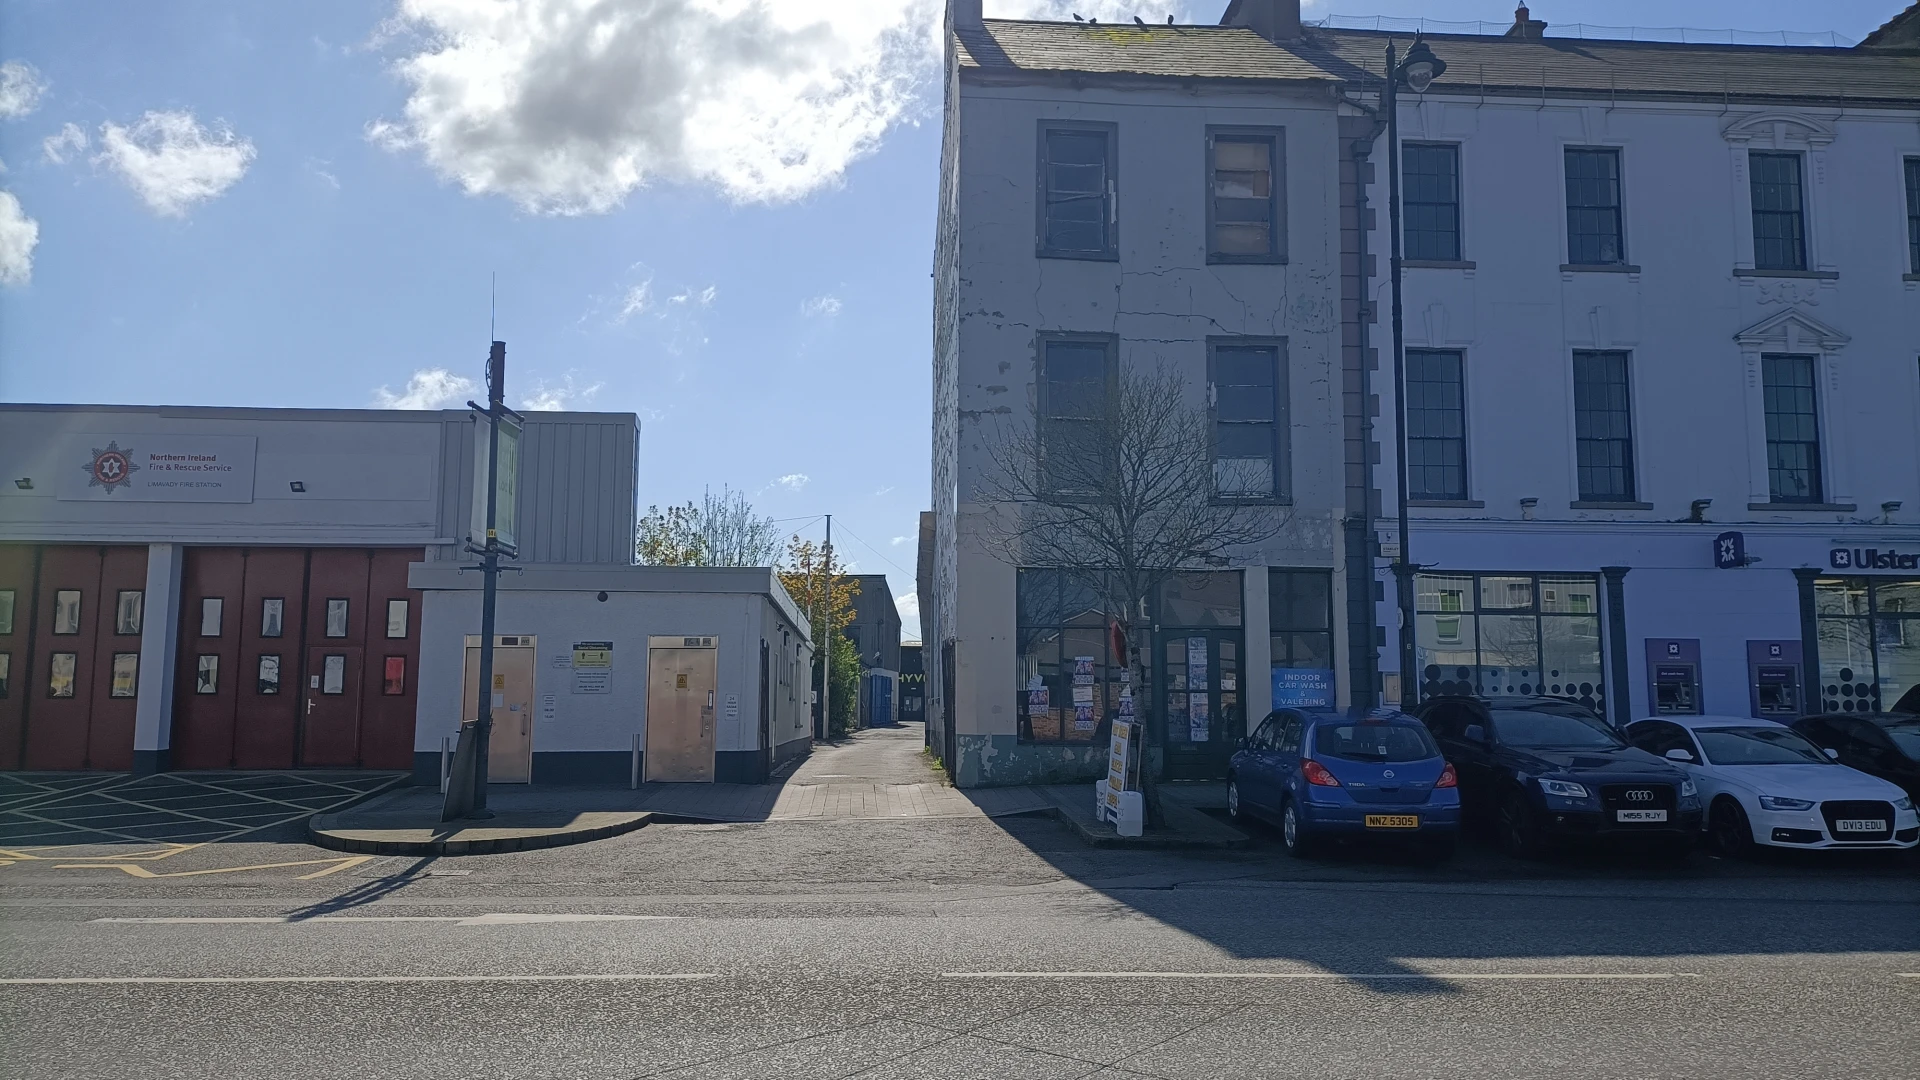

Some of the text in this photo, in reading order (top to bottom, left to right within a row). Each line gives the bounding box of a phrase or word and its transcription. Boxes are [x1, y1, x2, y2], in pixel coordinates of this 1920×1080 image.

[150, 453, 217, 462] Northern Ireland
[149, 463, 164, 471] Fire
[203, 464, 232, 472] Service
[1854, 548, 1920, 569] Ulster
[1284, 673, 1321, 682] INDOOR
[1278, 682, 1328, 690] CAR WASH
[1281, 698, 1327, 706] VALETING
[1645, 812, 1662, 820] RJY
[1369, 816, 1415, 826] NNZ 5305
[1843, 821, 1882, 830] DV13 EDU
